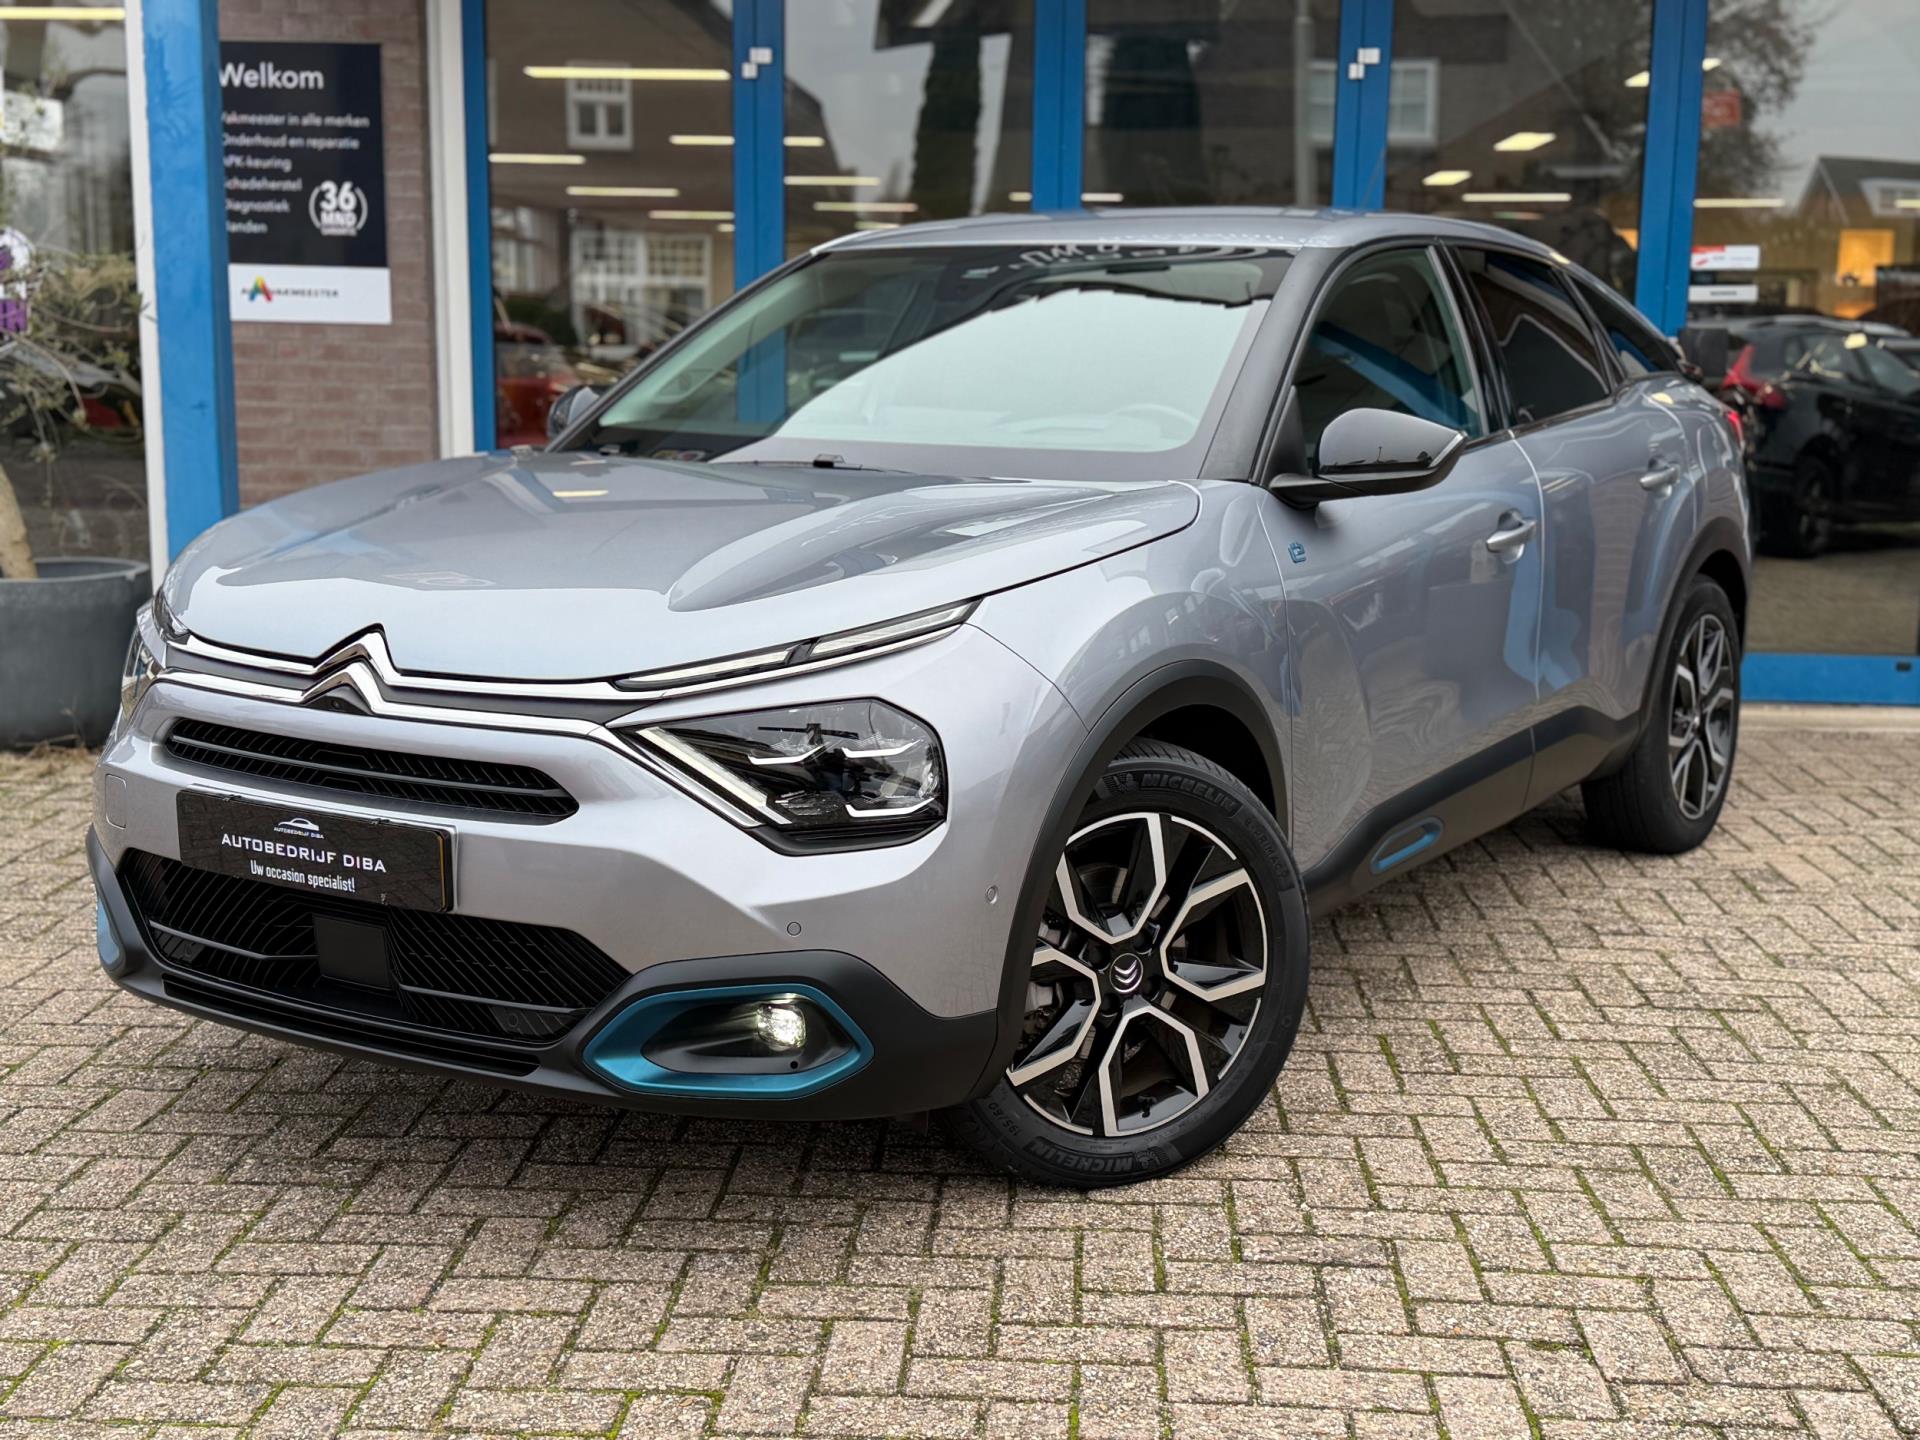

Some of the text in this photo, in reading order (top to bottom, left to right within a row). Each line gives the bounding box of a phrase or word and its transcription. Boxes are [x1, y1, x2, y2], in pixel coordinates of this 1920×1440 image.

[219, 62, 324, 89] Welkom
[287, 113, 299, 126] in
[301, 113, 322, 127] alle
[324, 114, 370, 128] merken
[289, 136, 304, 148] en
[320, 180, 357, 211] 36
[1141, 772, 1237, 811] MICHELIN
[221, 833, 387, 873] AUTOBEDRIJF DIBA
[250, 859, 356, 893] Uw occasion specialist!
[1024, 1140, 1134, 1171] MICHELIN
